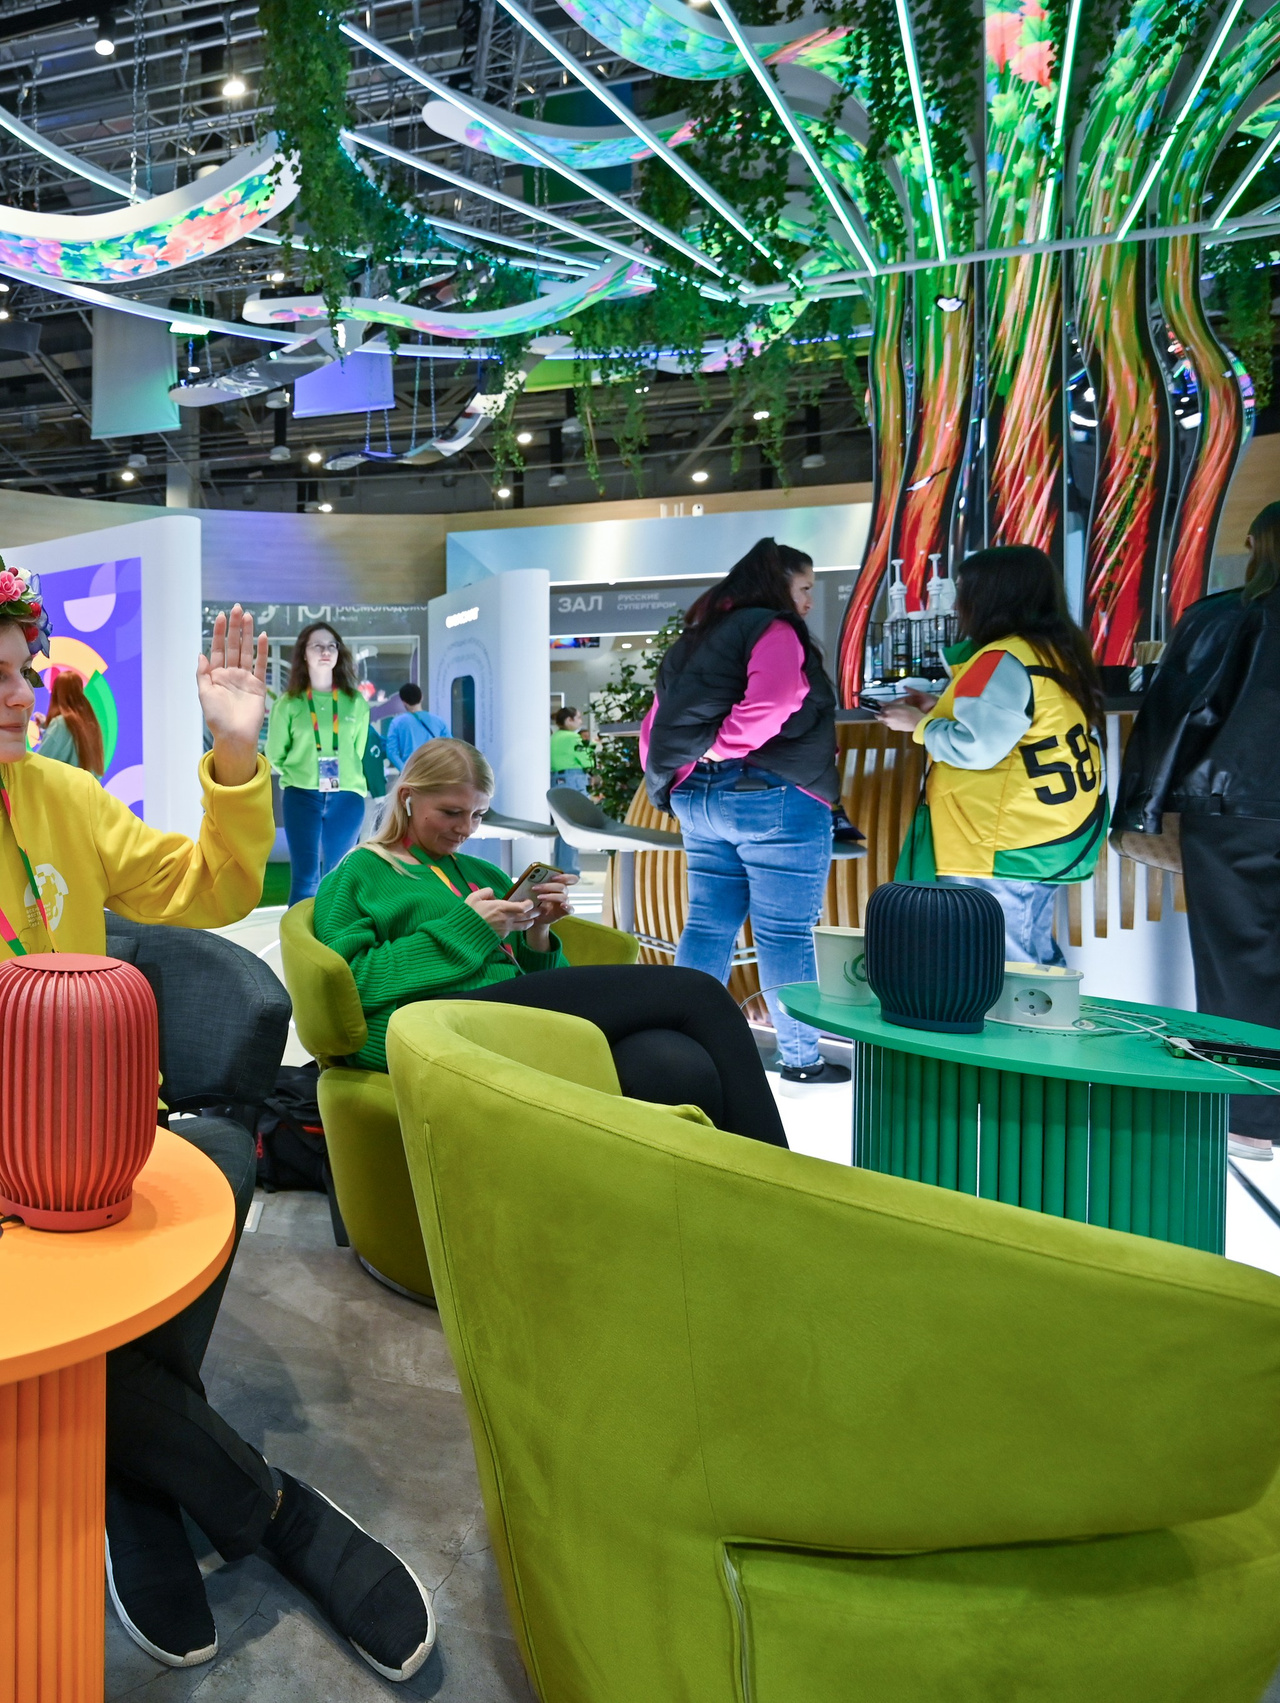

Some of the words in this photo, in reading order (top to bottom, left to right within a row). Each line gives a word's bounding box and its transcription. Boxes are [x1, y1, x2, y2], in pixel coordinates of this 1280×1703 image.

[558, 595, 603, 613] ЗАЛ
[617, 592, 661, 602] РУССКИЕ
[1018, 722, 1097, 806] 58
